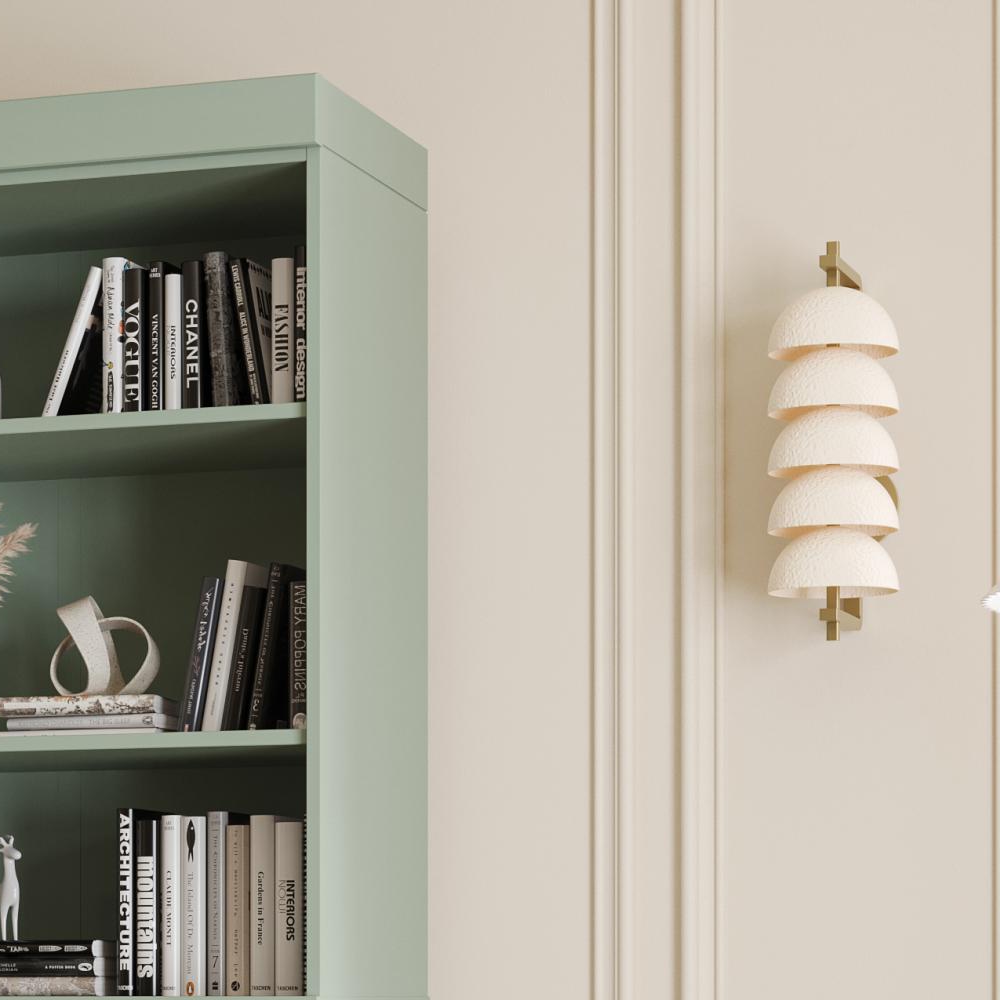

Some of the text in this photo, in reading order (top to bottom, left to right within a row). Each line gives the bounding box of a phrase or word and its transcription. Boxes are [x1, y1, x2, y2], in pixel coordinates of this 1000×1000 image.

[124, 298, 140, 402] VOGUE
[185, 299, 198, 389] CHANEL
[274, 304, 288, 372] FASHION
[295, 338, 306, 400] design
[119, 813, 130, 972] ARCHITECTURE
[186, 872, 194, 886] The
[186, 888, 194, 912] Island
[137, 856, 155, 978] mountains
[257, 907, 264, 916] in
[286, 880, 295, 941] INTERIORS
[212, 955, 218, 968] 7
